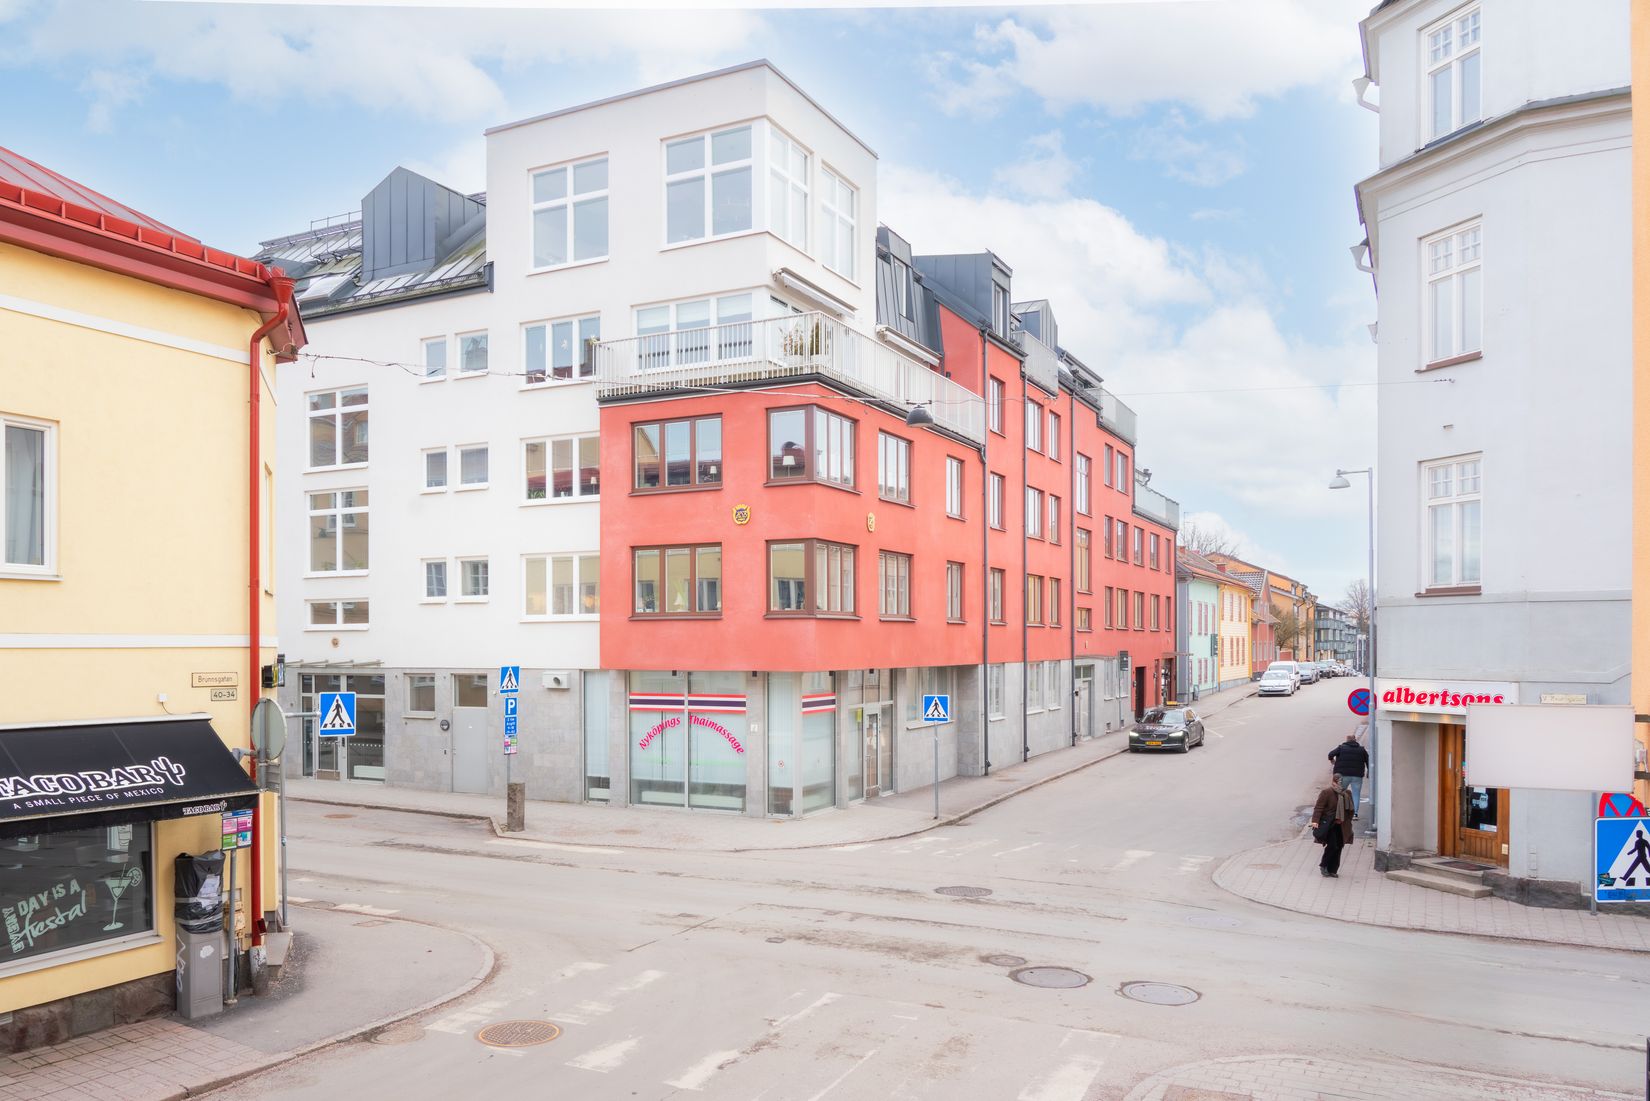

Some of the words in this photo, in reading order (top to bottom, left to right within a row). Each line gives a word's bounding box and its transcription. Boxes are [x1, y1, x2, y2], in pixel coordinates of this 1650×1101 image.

[197, 675, 233, 684] Brunnsgatan
[507, 699, 516, 715] P
[1382, 687, 1505, 707] albertsons
[639, 716, 681, 750] Nyköpings
[25, 798, 66, 808] SMALL
[68, 794, 103, 804] PIECE
[106, 792, 119, 800] OF
[125, 787, 164, 798] MEXICO
[17, 890, 49, 917] DAY
[52, 883, 66, 900] IS
[70, 878, 81, 895] A
